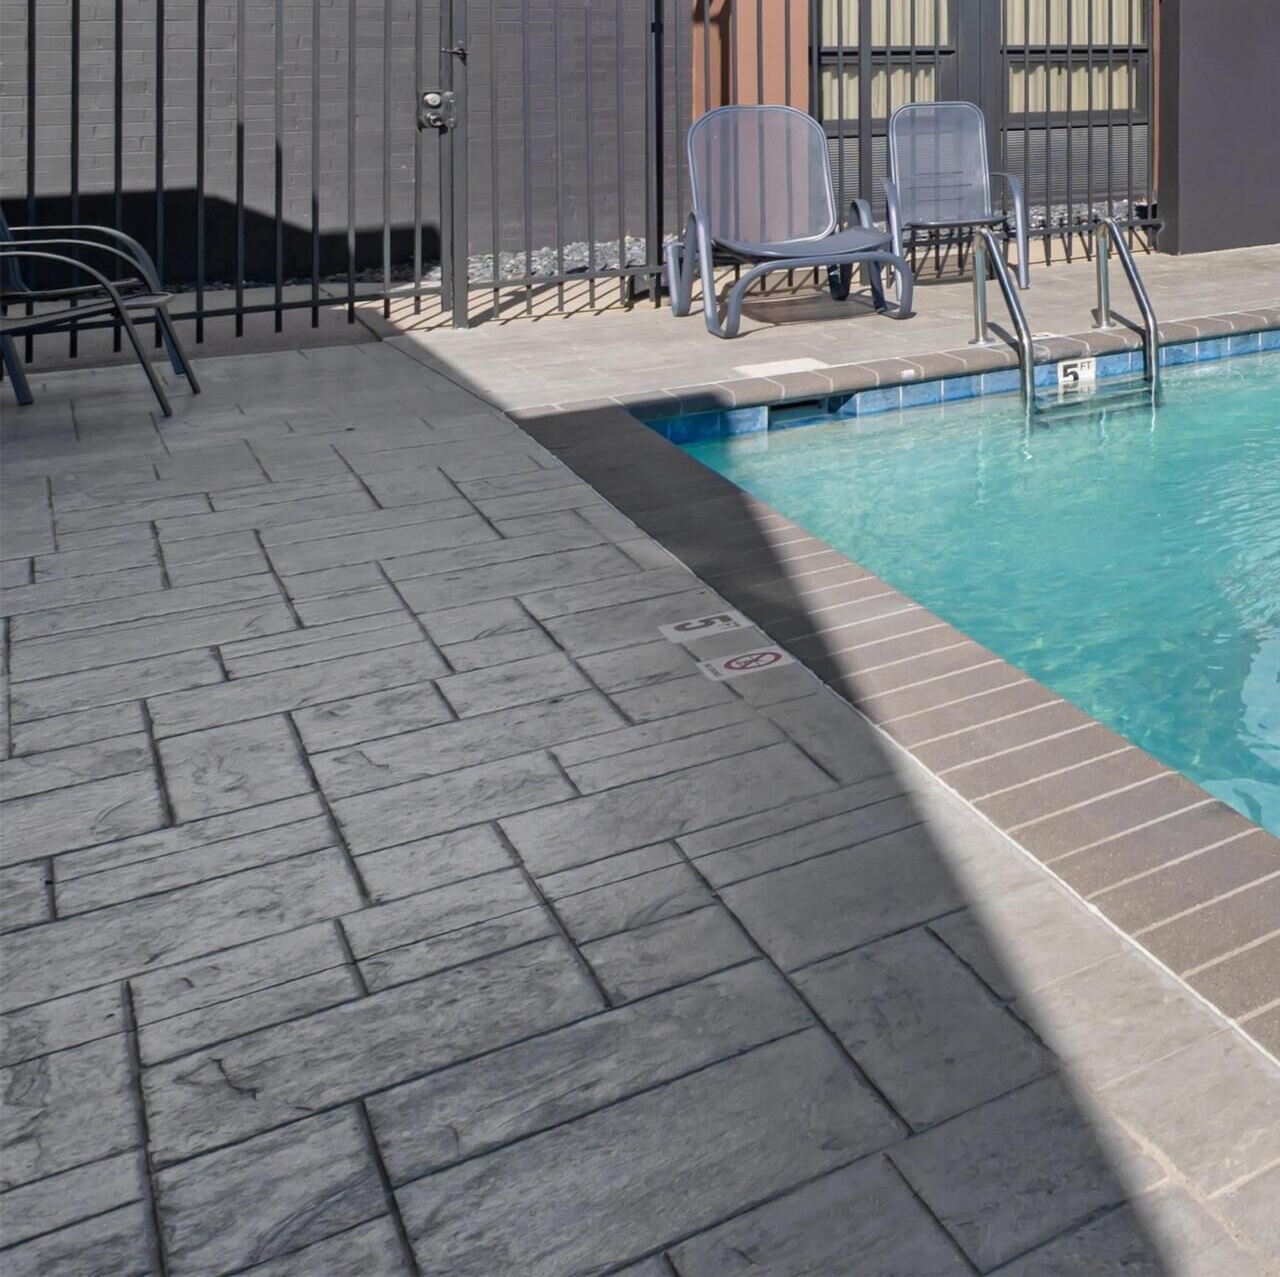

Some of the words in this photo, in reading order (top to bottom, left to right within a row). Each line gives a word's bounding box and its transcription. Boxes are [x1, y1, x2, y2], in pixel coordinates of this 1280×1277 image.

[1063, 363, 1079, 382] 5
[1080, 361, 1092, 370] FT
[674, 614, 733, 632] 5
